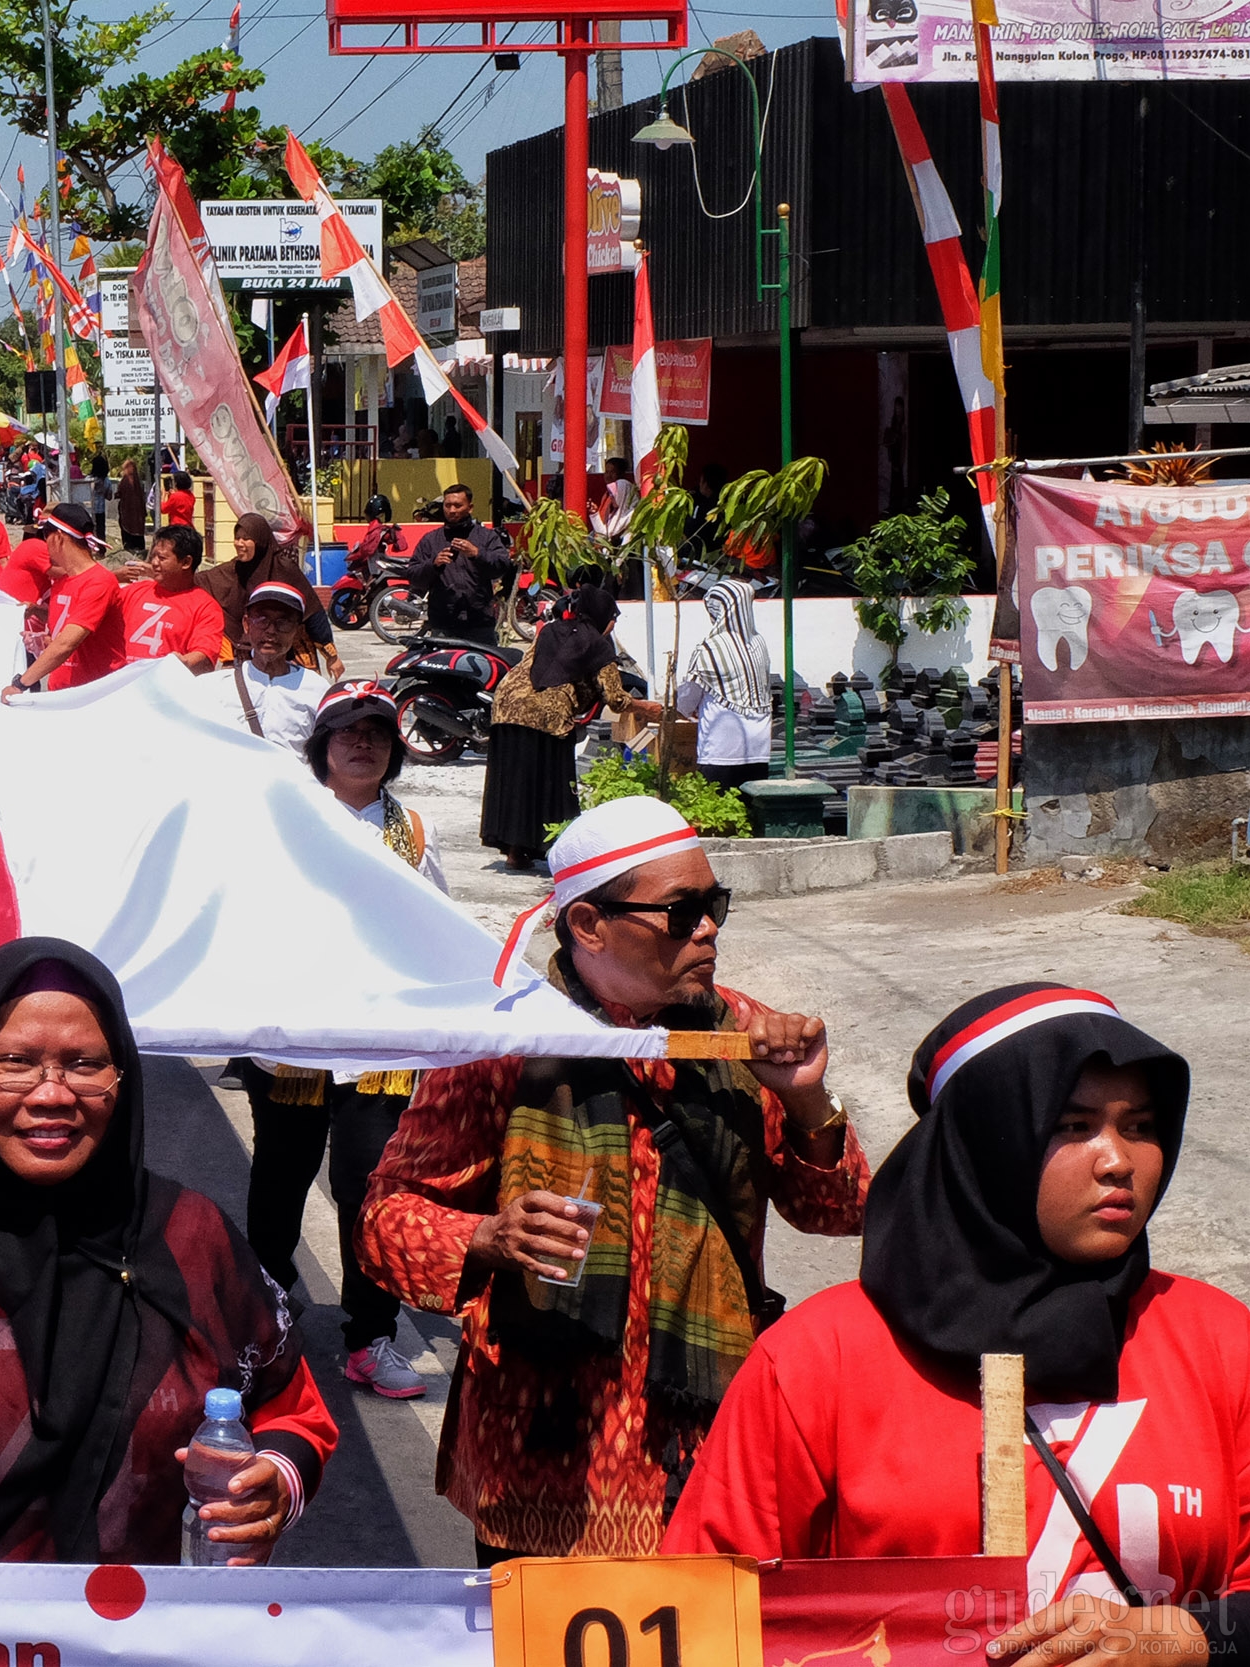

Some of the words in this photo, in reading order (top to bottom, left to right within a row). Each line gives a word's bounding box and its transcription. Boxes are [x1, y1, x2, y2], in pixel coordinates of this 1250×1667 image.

[933, 23, 1025, 43] MANRIN,
[1029, 22, 1114, 41] BROWNIES,
[1117, 22, 1159, 41] ROLL
[1161, 22, 1206, 42] CAKE,
[1208, 22, 1250, 39] LAPIS
[942, 52, 962, 62] Jln.
[996, 52, 1055, 65] Nanggulan
[1058, 51, 1089, 61] Kulon
[1093, 51, 1129, 63] Progo,
[206, 205, 233, 216] YAYASAN
[235, 205, 261, 216] KRISTEN
[263, 206, 285, 216] UNTUK
[286, 206, 320, 216] KESEHATA
[239, 246, 278, 262] PRATAMA
[280, 245, 321, 262] BETHESDA
[588, 243, 621, 268] Chicken
[241, 278, 284, 289] BUKA
[286, 278, 307, 288] 24
[309, 278, 341, 288] JAM
[105, 351, 114, 359] Dr.
[116, 350, 135, 358] YISKA
[107, 409, 131, 417] NATALIA
[132, 408, 149, 416] DEBBY
[1034, 539, 1235, 582] PERIKSA
[1027, 708, 1067, 722] Alamat
[1074, 706, 1116, 721] Karang
[1133, 702, 1196, 718] Jatisarono,
[1168, 1484, 1203, 1518] TH
[563, 1604, 682, 1667] 01
